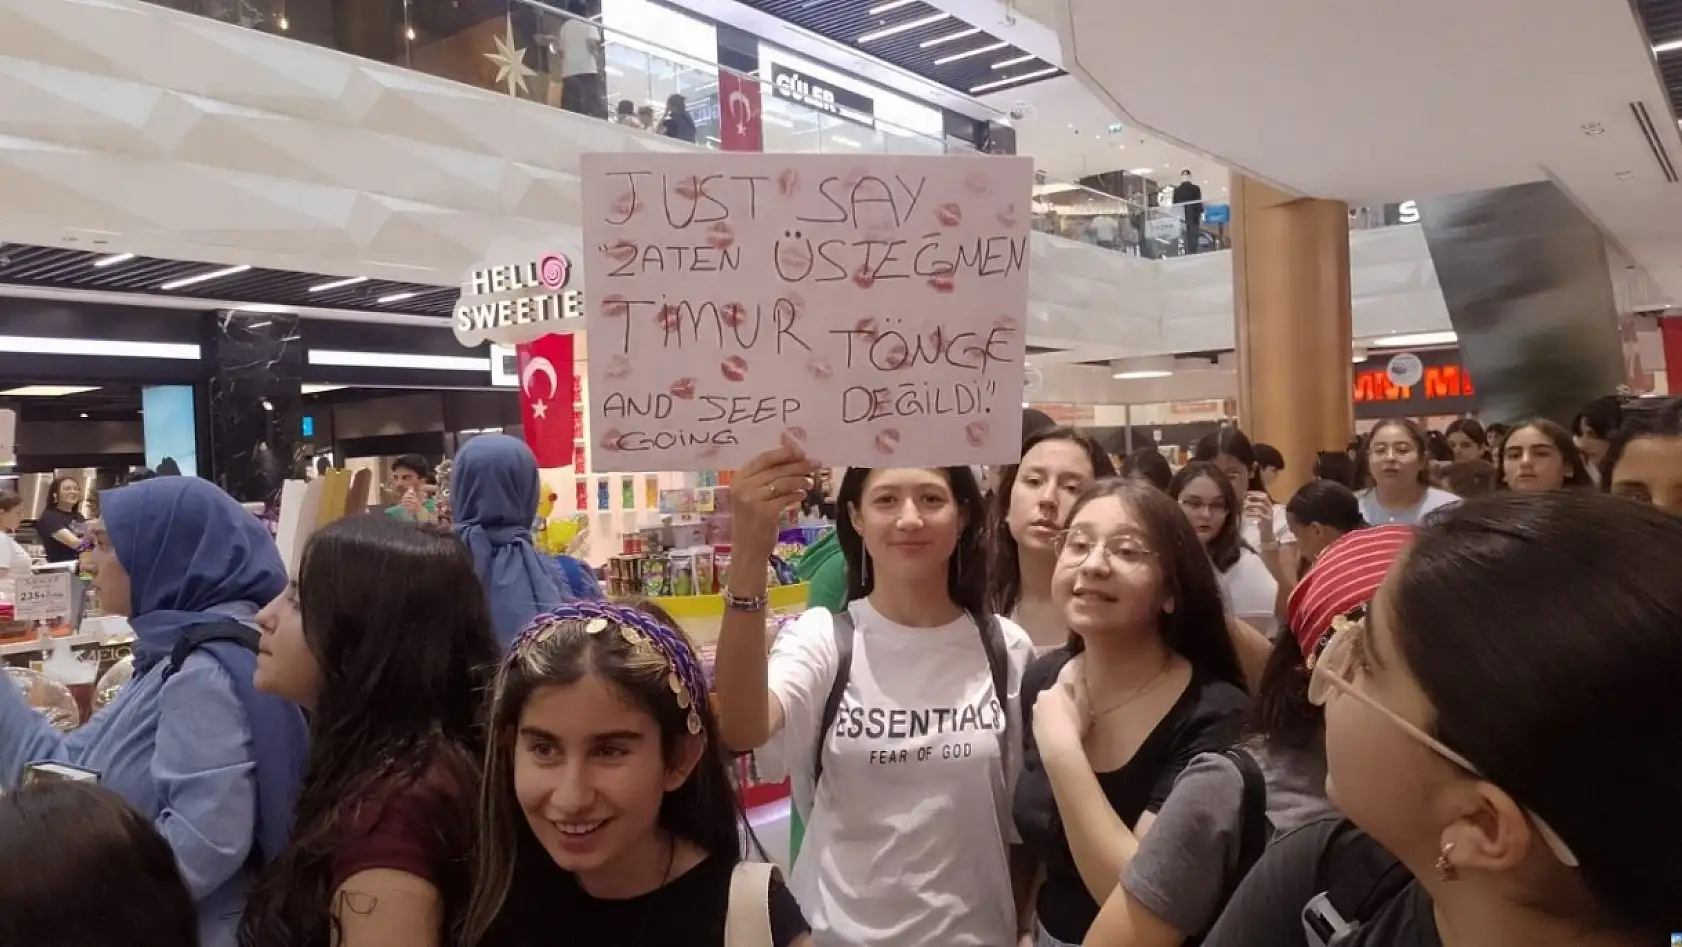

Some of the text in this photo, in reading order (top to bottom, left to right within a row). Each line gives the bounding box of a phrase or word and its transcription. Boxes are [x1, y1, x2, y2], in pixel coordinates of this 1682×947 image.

[775, 73, 837, 112] GÜLER
[604, 170, 926, 229] JUST SAY
[457, 289, 582, 332] SWEETIE
[828, 318, 1016, 374] TÖNGE
[603, 391, 673, 420] AND
[836, 699, 1001, 739] ESSENTIALS
[869, 743, 972, 765] FEAR OF GOD
